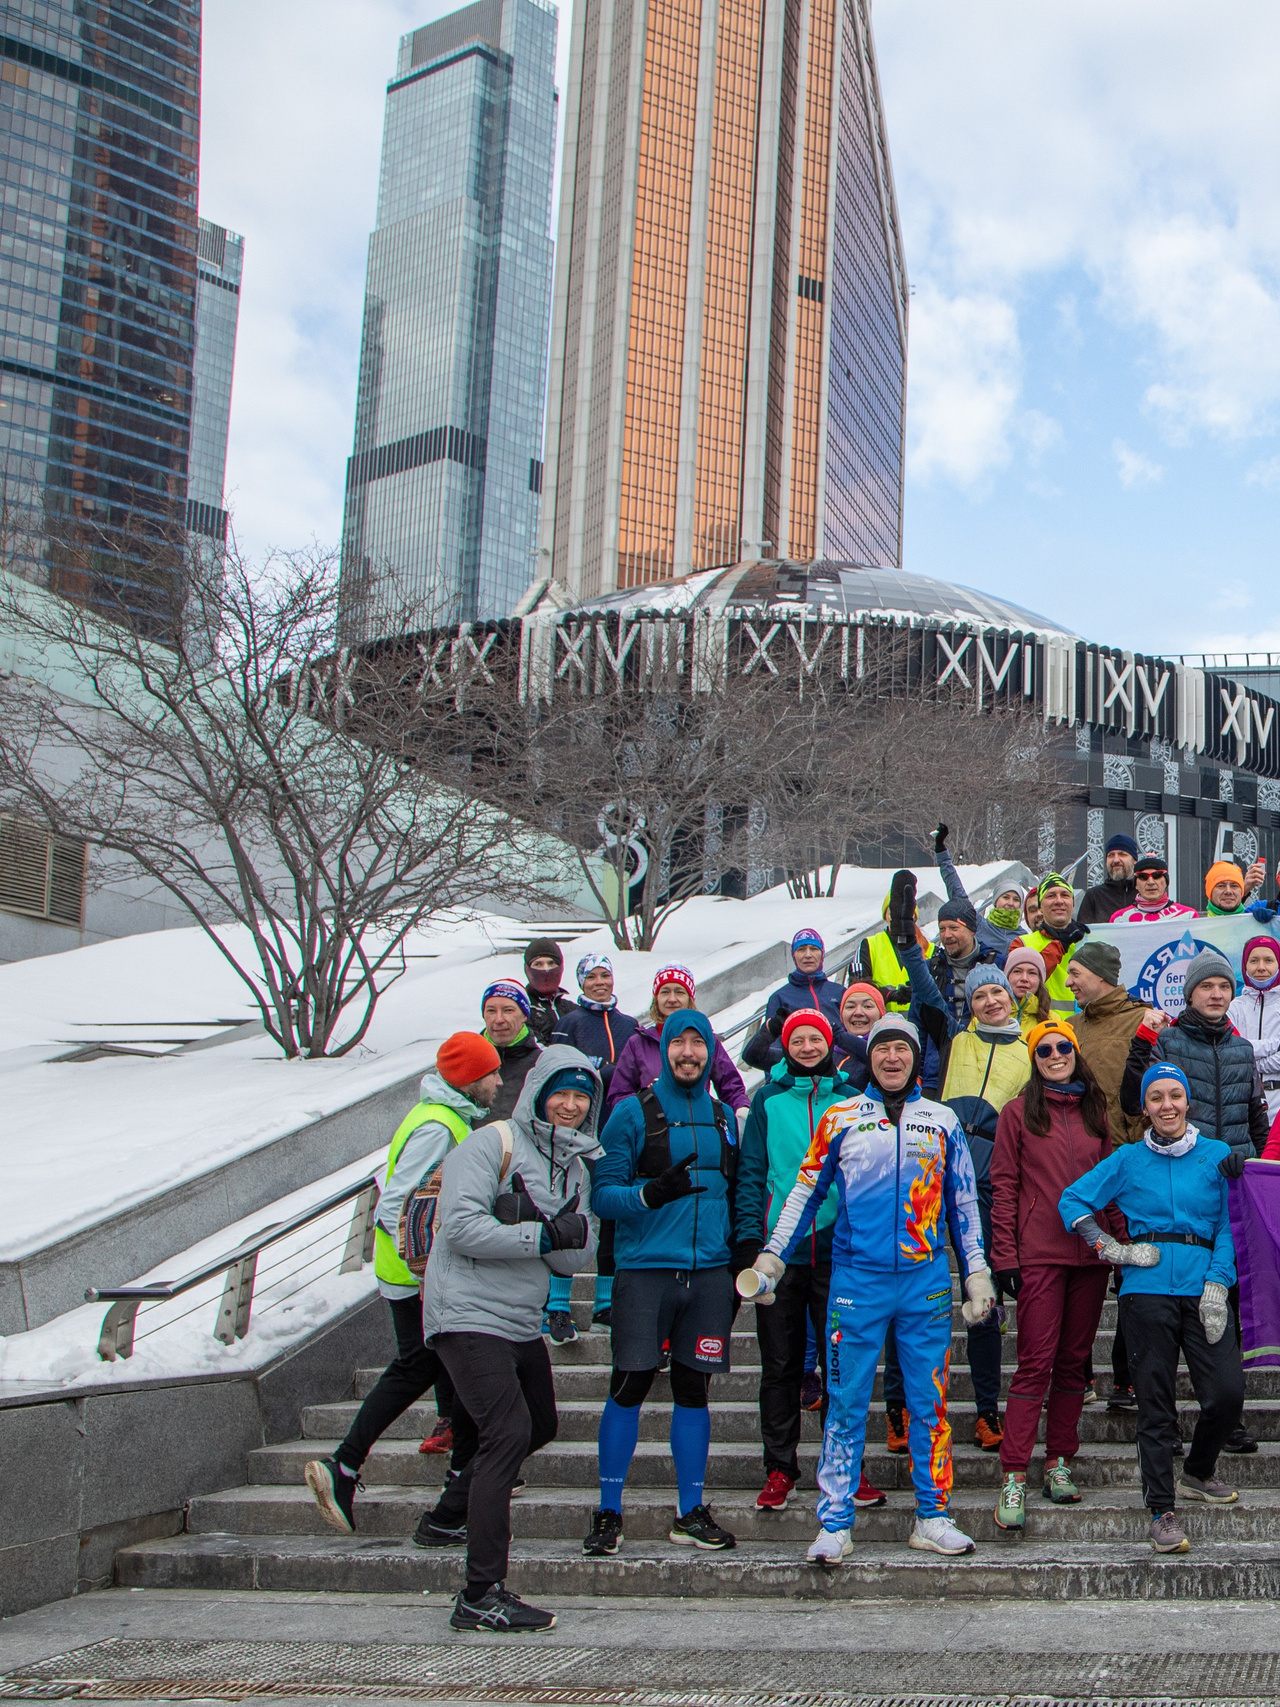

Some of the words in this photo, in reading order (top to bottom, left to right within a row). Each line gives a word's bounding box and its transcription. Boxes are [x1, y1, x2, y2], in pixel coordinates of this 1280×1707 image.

[742, 622, 865, 678] XVII
[936, 634, 1032, 695] XVI
[1104, 658, 1170, 717] XV
[1220, 688, 1274, 749] XIV
[1164, 999, 1186, 1007] стол
[858, 1122, 876, 1132] GO
[905, 1123, 937, 1135] SPORT
[831, 1310, 840, 1329] GO
[836, 1297, 853, 1305] OLLY
[831, 1342, 841, 1384] SPORT
